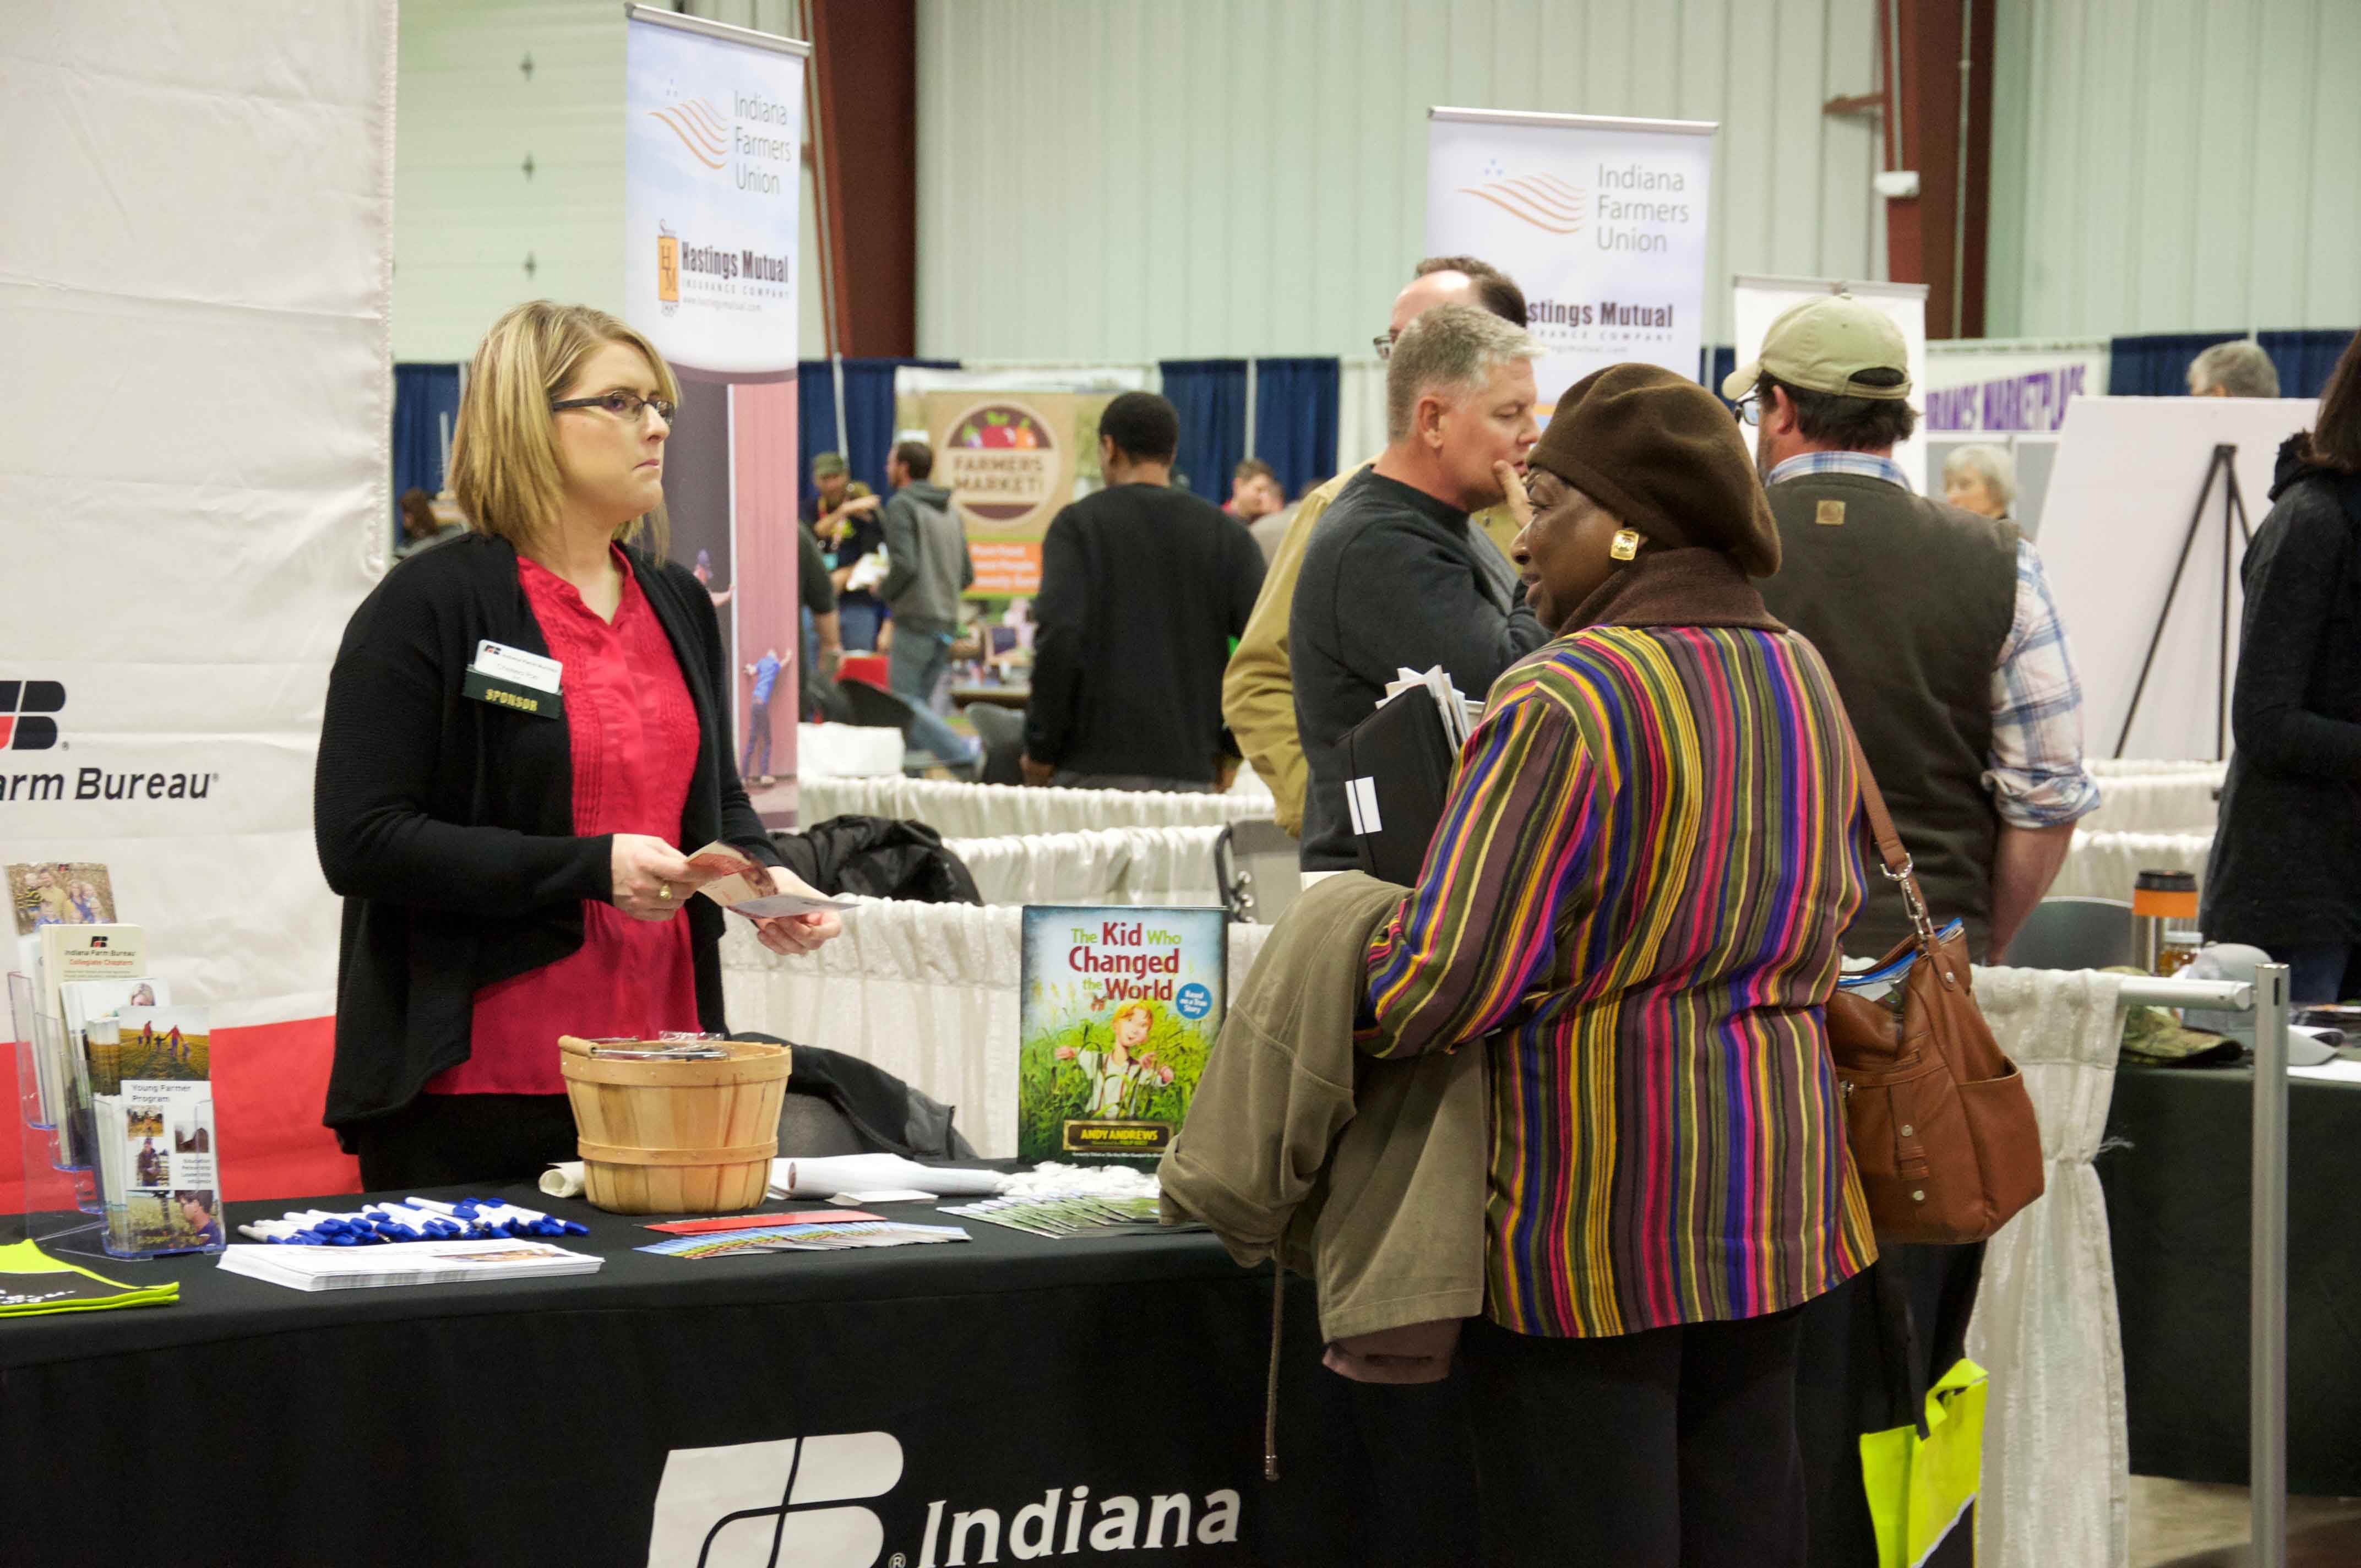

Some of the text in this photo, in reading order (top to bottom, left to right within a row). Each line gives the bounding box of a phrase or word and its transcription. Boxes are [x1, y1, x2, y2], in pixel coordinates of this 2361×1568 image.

[734, 90, 787, 126] Indiana
[735, 126, 791, 162] Farmers
[736, 162, 780, 194] Union
[1598, 164, 1684, 191] Indiana
[1598, 194, 1689, 224] Farmers
[1597, 226, 1667, 252] Union
[682, 241, 788, 283] Hastings Mutual
[1528, 298, 1673, 328] stings Mutual
[954, 456, 1043, 471] FARMERS
[75, 767, 210, 799] Bureau
[1071, 922, 1181, 946] The Kid Who
[1069, 946, 1179, 980] Changed
[1083, 978, 1173, 1001] the World
[1080, 1129, 1159, 1141] ANDY ANDREWS
[916, 1486, 1241, 1568] Indiana
